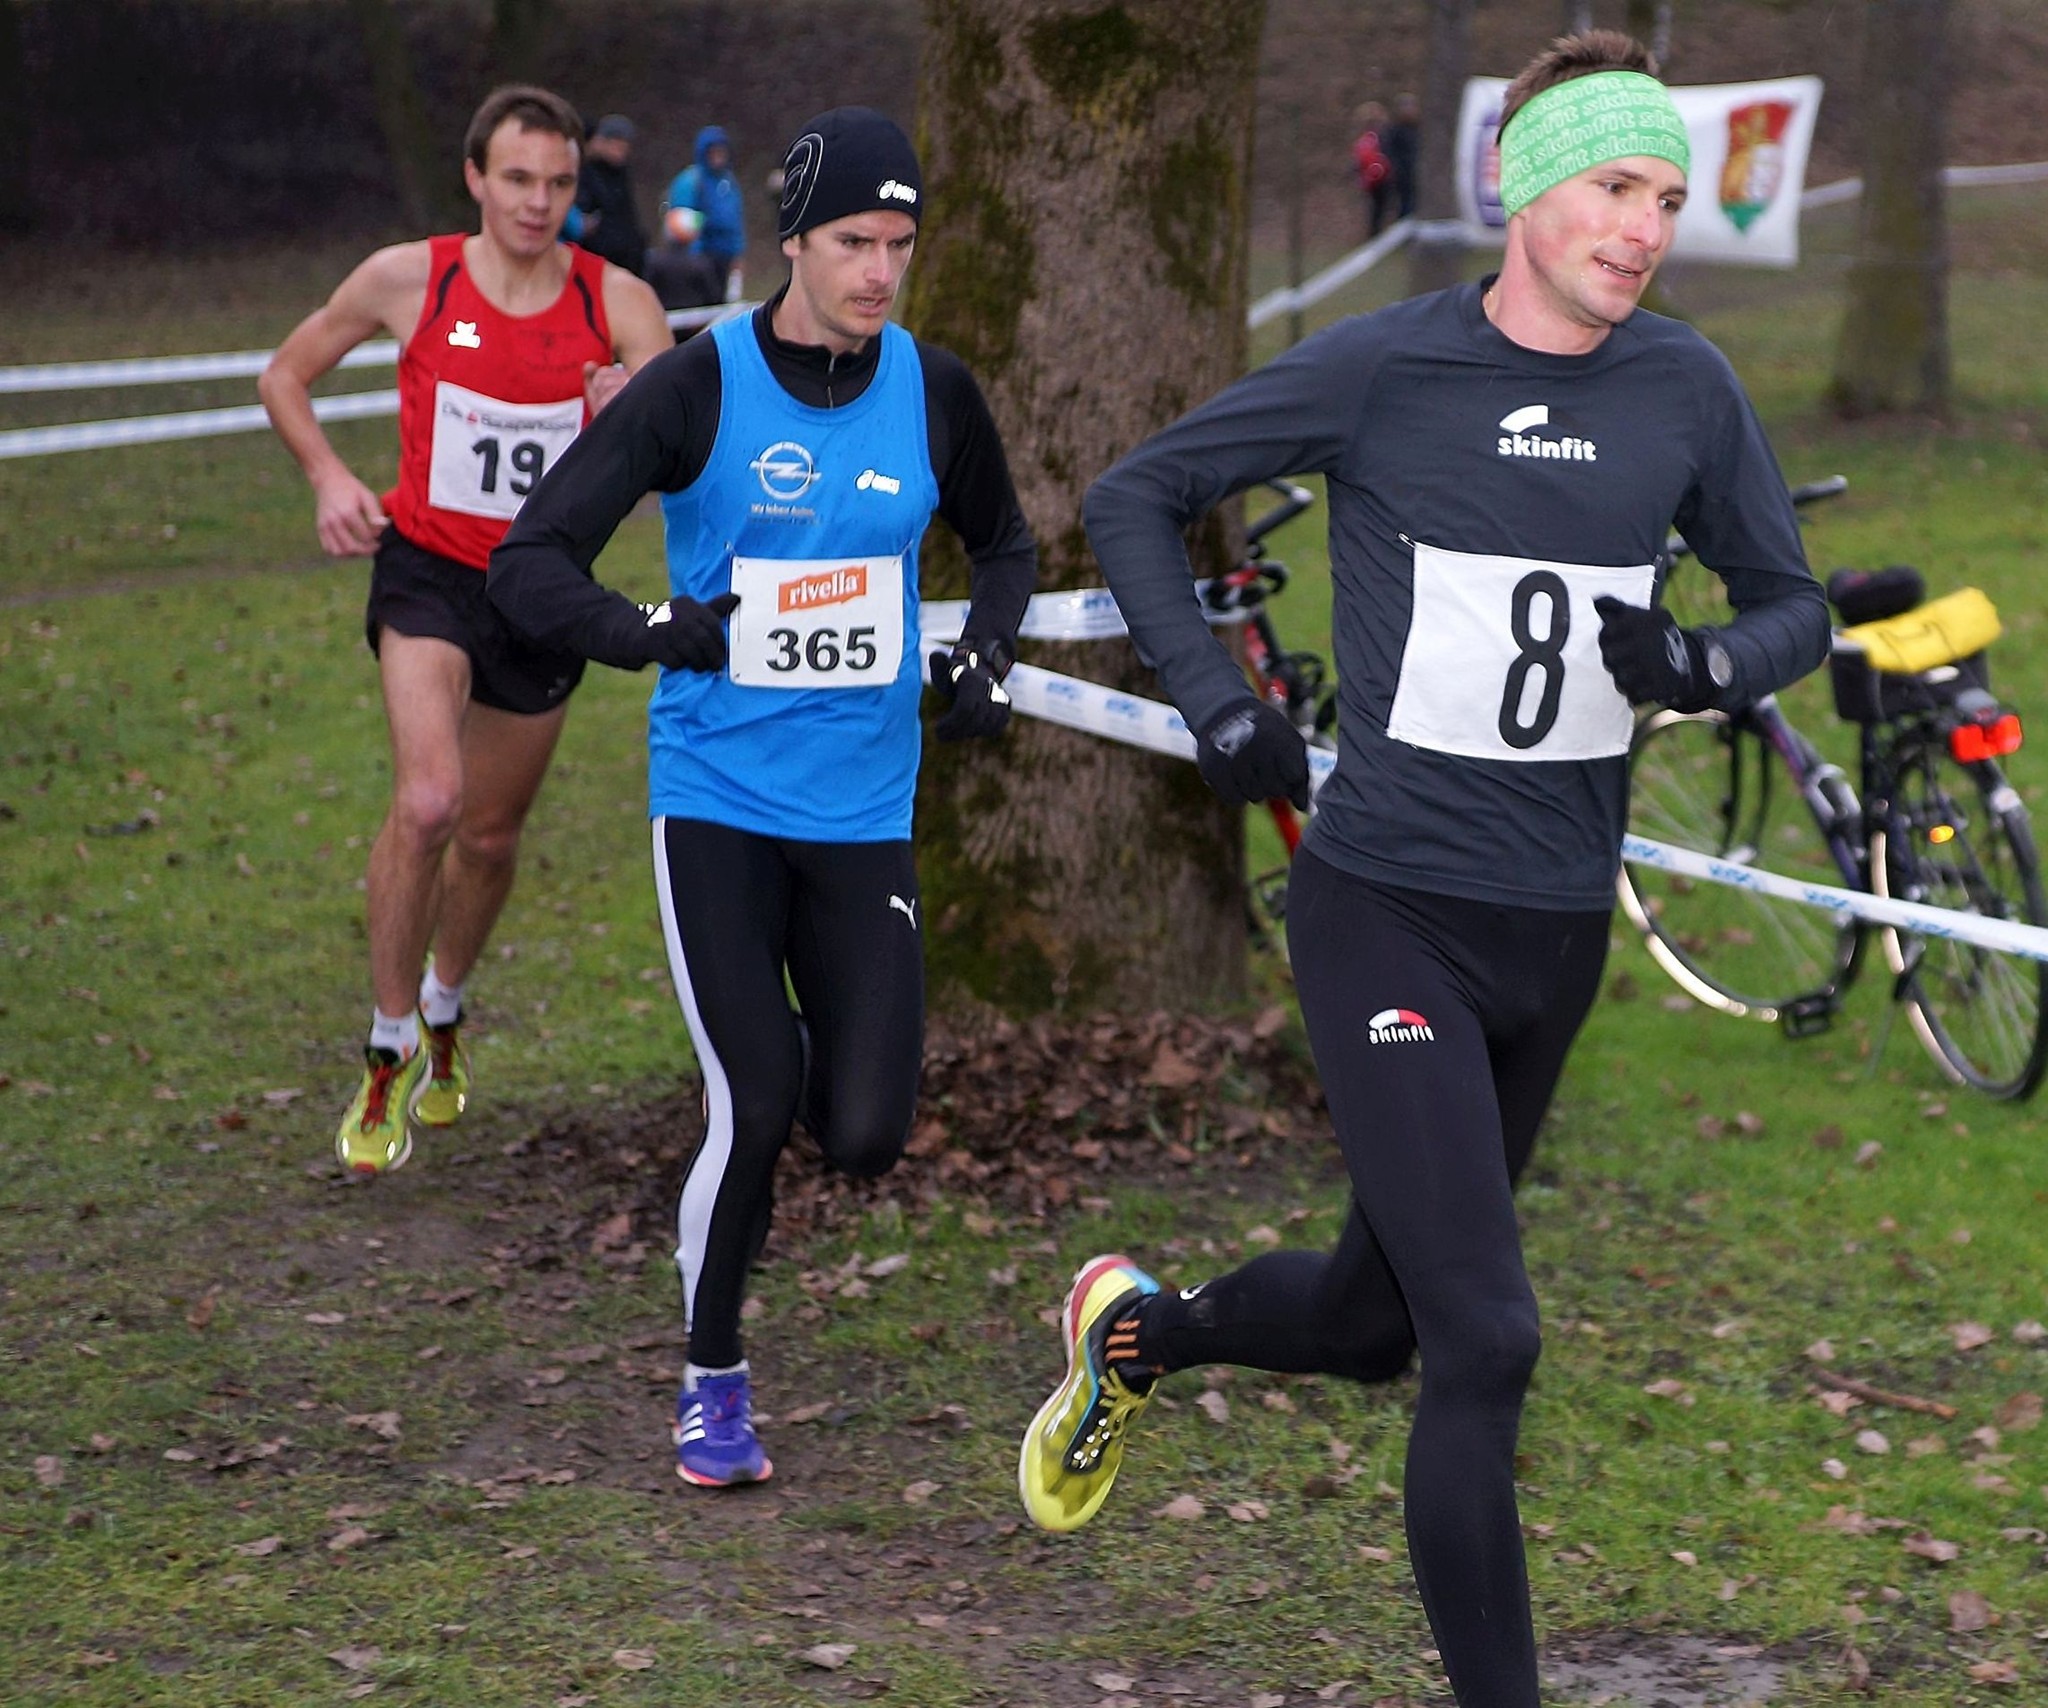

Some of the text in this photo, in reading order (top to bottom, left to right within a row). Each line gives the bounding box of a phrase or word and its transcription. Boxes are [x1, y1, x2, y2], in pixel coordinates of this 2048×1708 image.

[1533, 110, 1636, 165] skinfit
[1507, 148, 1590, 210] skinfit
[472, 437, 544, 496] 19
[1497, 433, 1597, 462] skinfit
[788, 570, 859, 606] rivella
[765, 625, 877, 672] 365
[1498, 569, 1570, 749] 8
